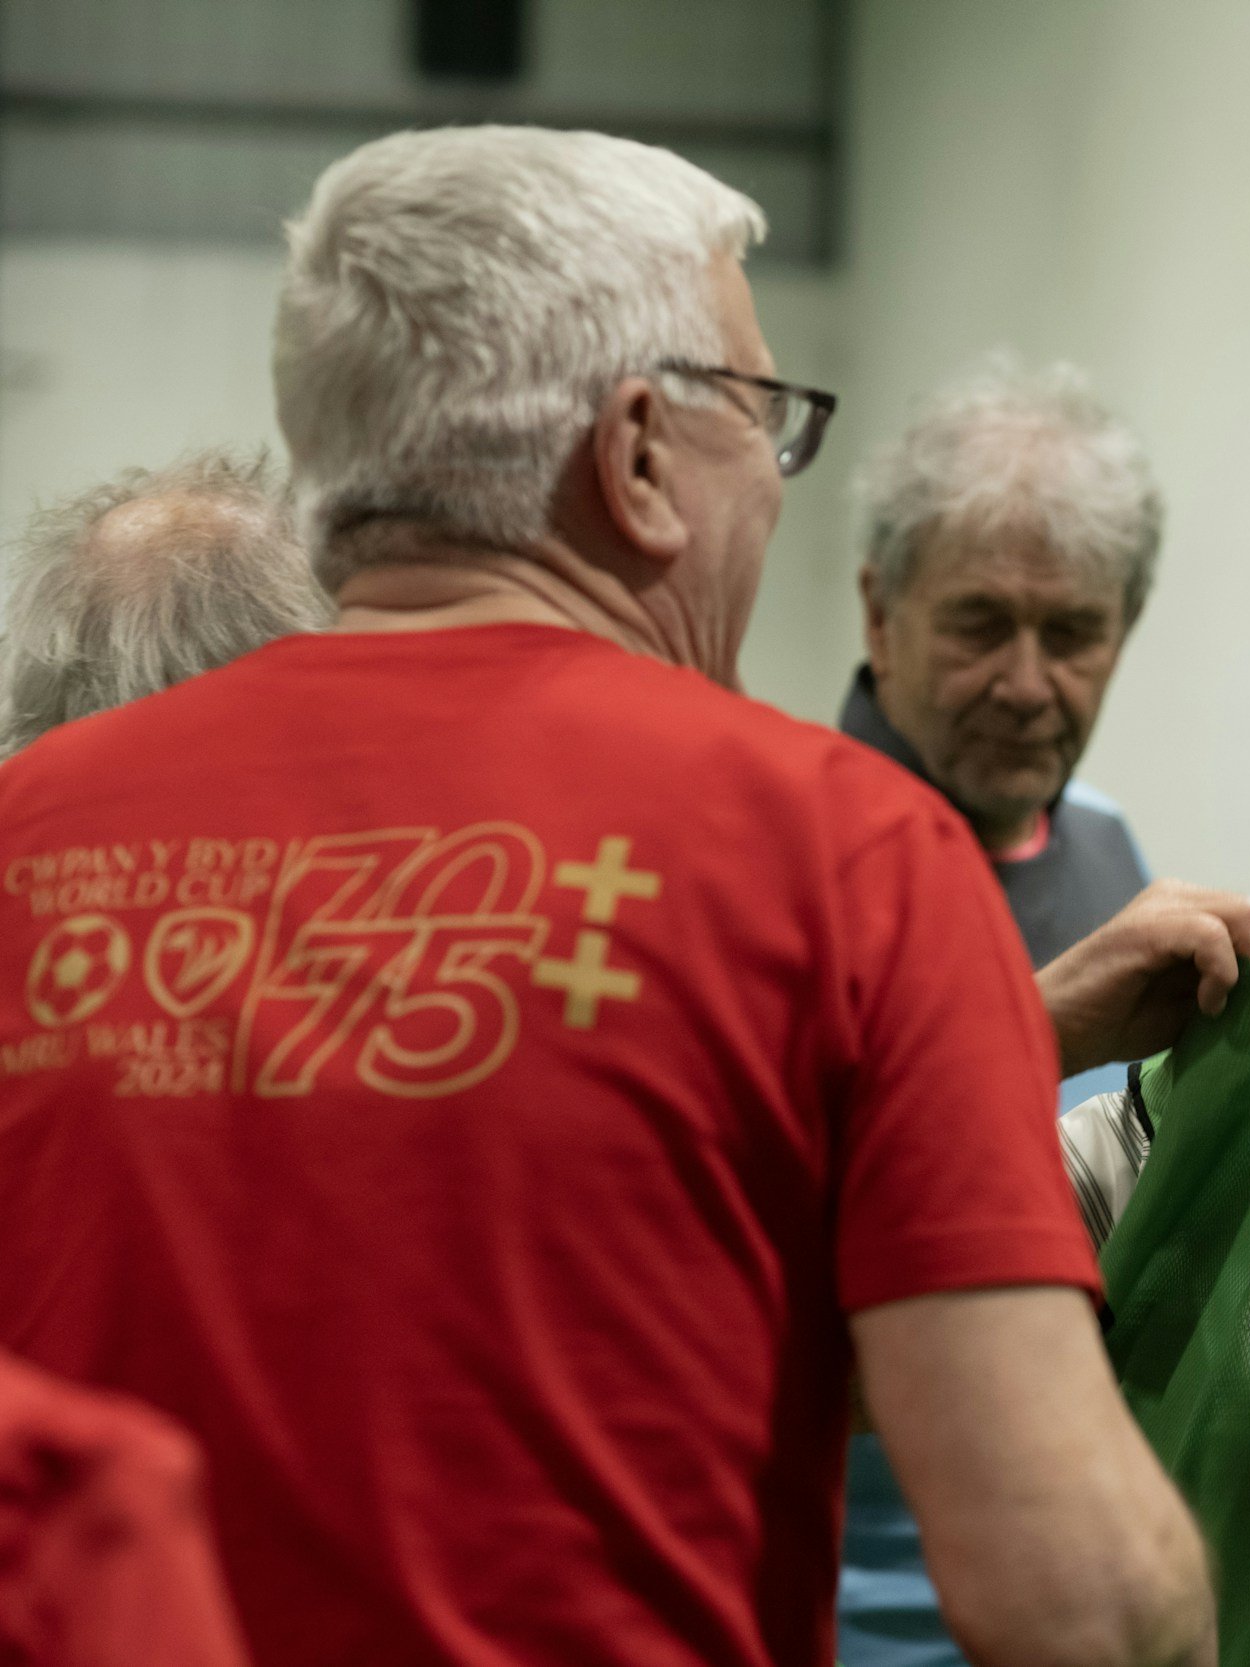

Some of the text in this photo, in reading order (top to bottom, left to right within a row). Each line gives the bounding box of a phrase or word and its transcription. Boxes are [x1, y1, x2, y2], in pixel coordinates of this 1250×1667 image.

[29, 868, 273, 917] WORLD CUP
[113, 1057, 225, 1098] 2024
